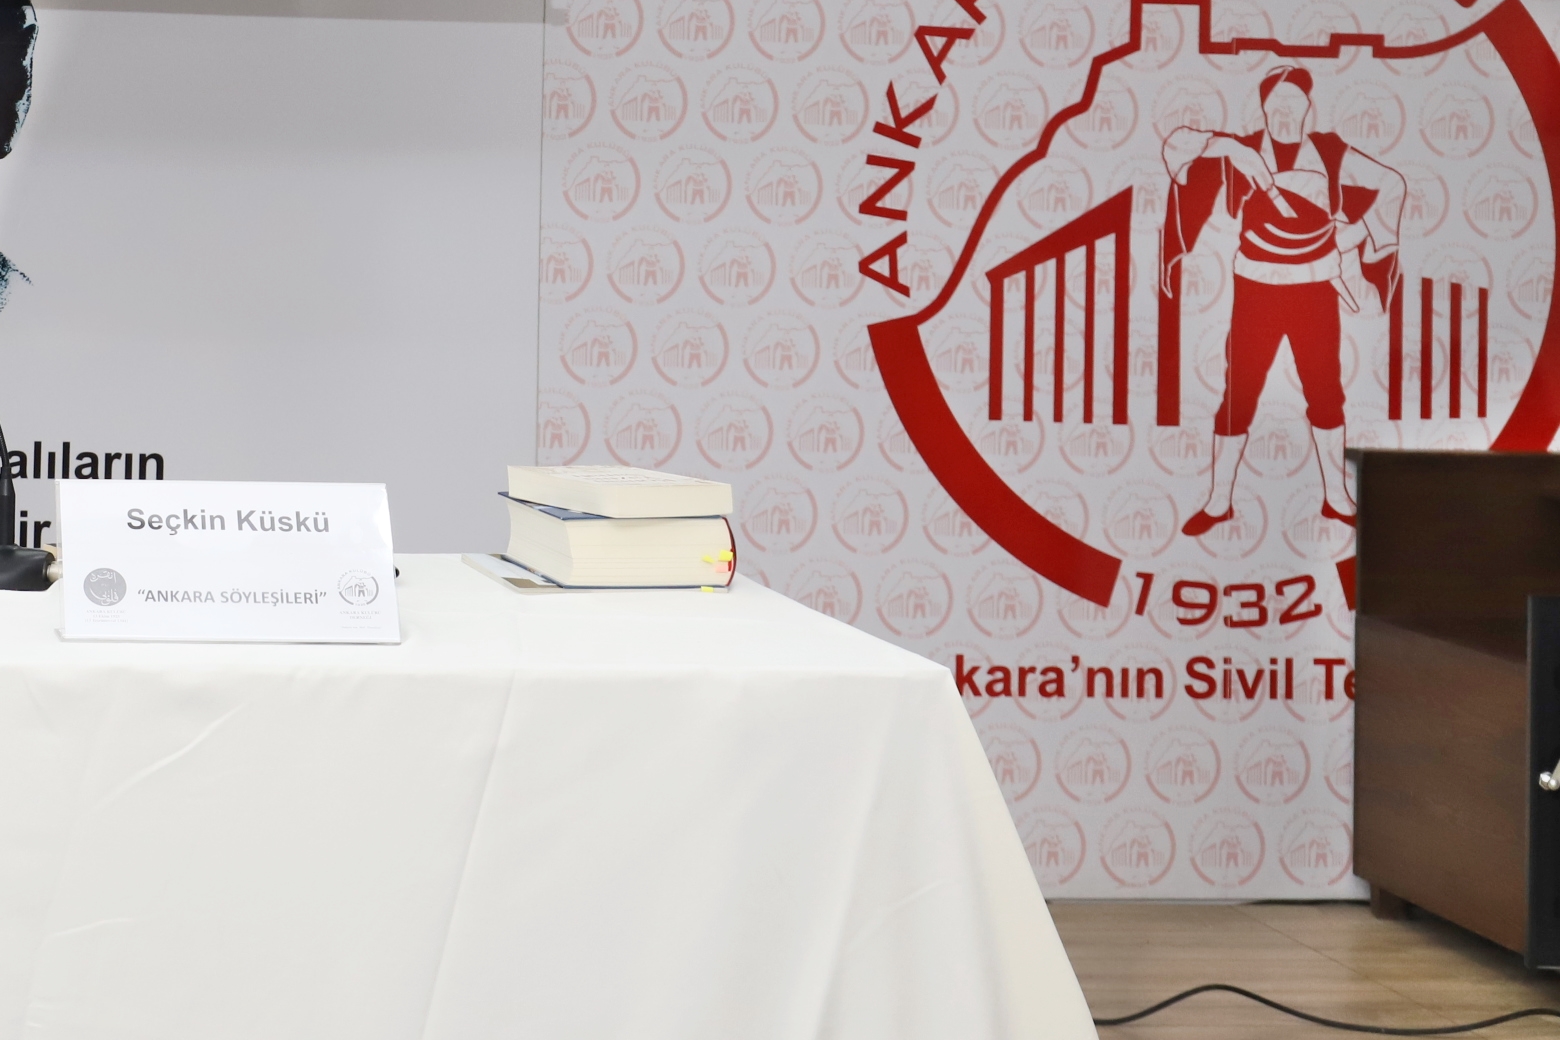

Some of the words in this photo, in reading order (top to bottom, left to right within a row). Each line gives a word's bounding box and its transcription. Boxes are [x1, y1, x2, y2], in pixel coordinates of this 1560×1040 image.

[126, 507, 227, 536] Seçkin
[236, 508, 331, 533] Küskü
[1133, 570, 1323, 629] 1932
[1184, 655, 1294, 701] Sivil
